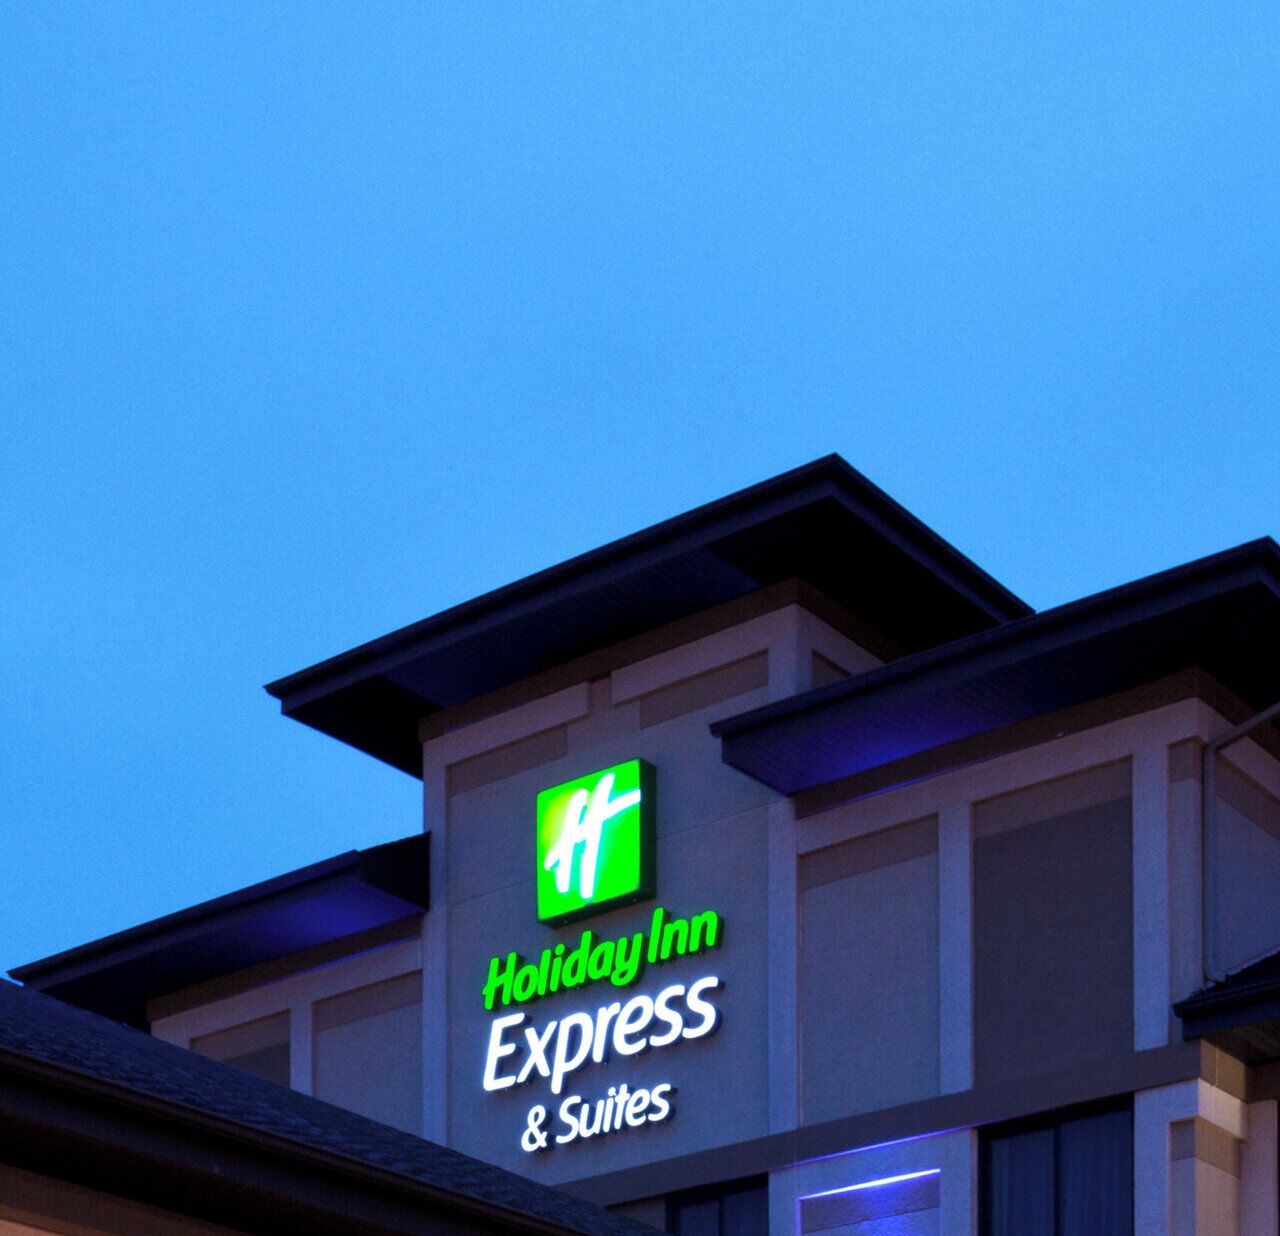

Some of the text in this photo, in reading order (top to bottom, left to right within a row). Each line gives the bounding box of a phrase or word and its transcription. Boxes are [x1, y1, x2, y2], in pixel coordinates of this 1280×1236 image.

[482, 907, 718, 1010] Holiday Inn
[483, 977, 719, 1094] Express
[521, 1084, 671, 1152] & Suites
